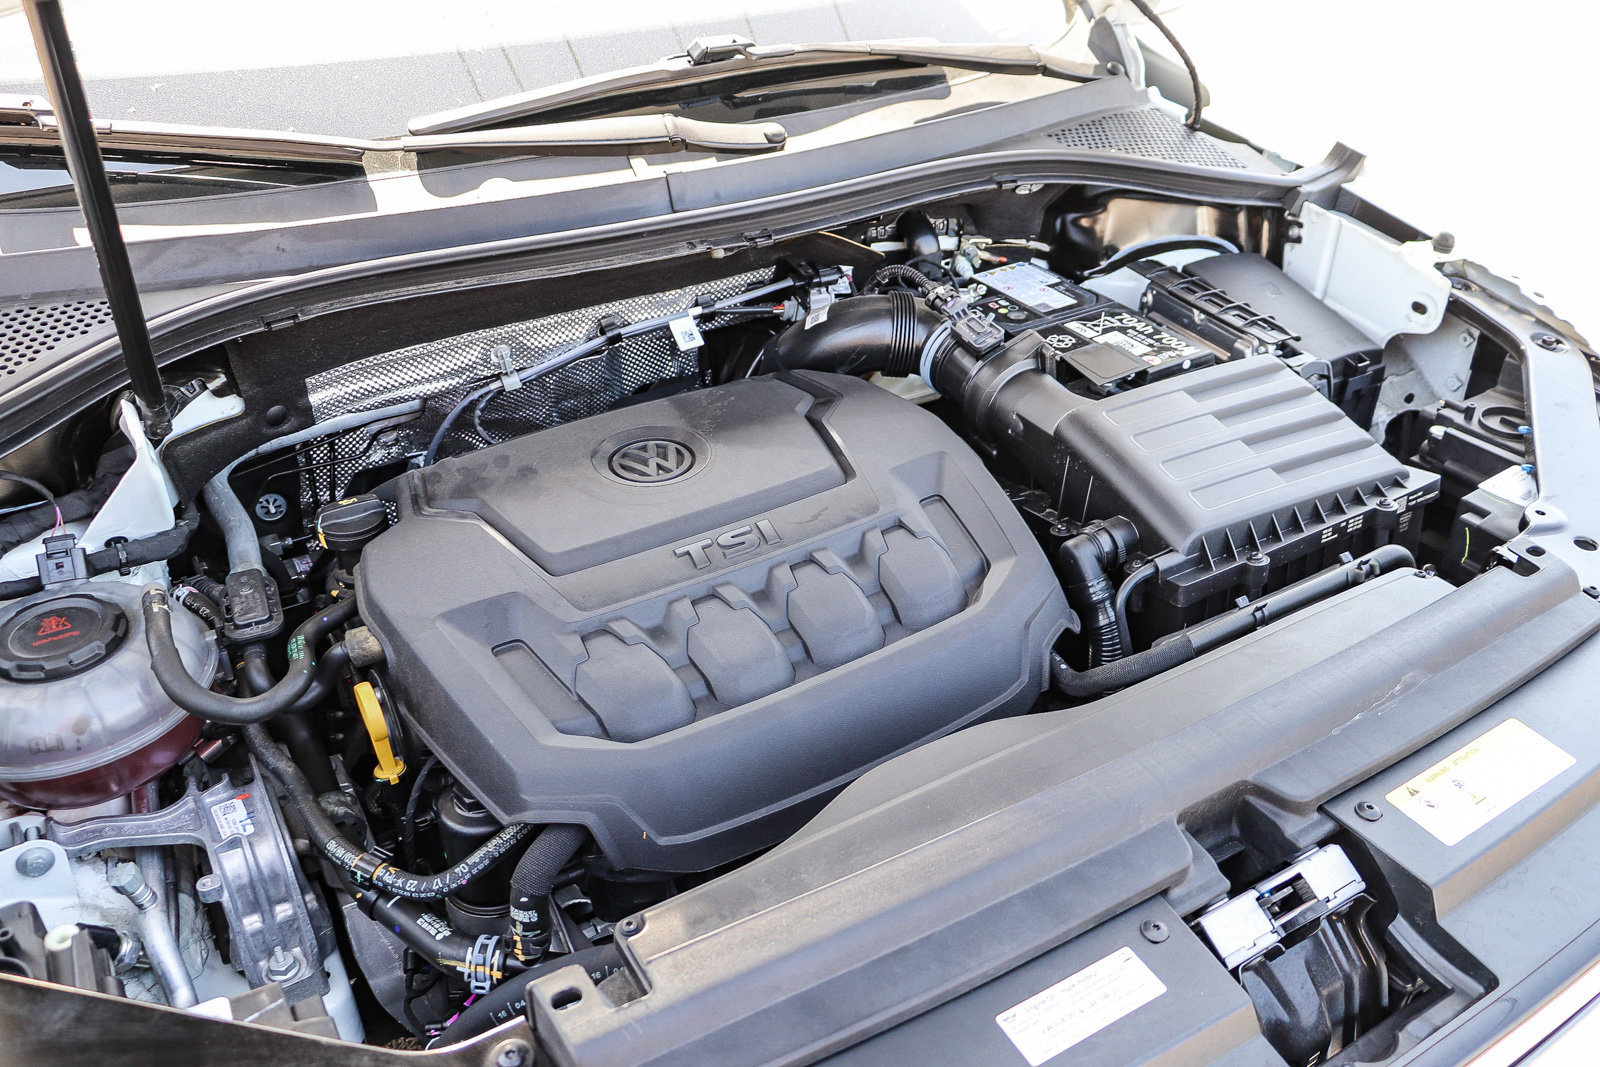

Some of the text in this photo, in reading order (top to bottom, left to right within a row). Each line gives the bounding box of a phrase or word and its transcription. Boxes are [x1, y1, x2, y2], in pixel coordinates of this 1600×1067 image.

[1115, 312, 1154, 335] 70Ah
[672, 518, 782, 570] TSI
[405, 879, 419, 892] 23
